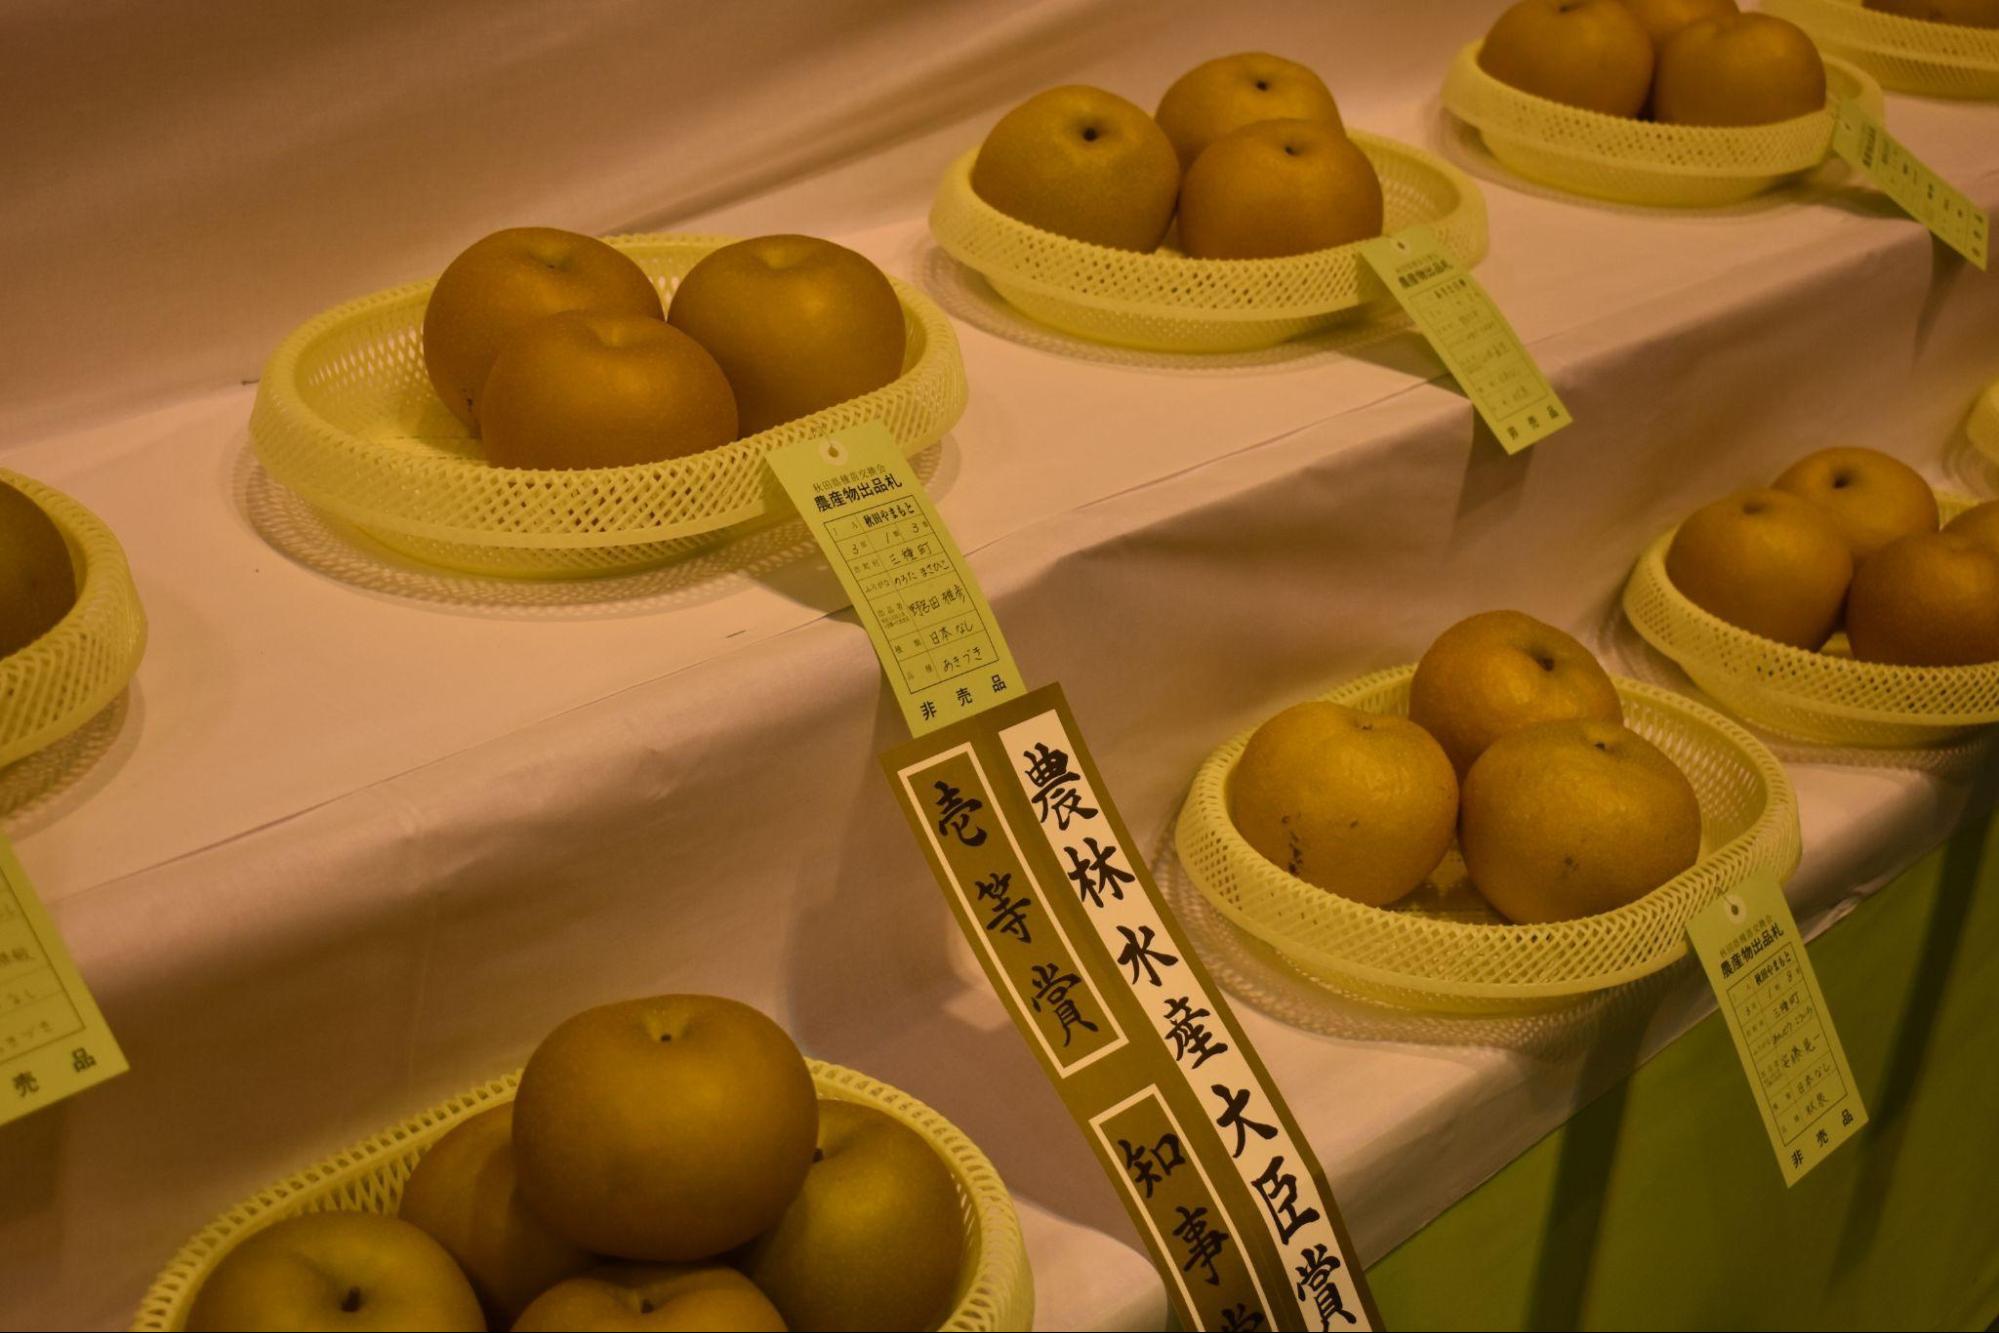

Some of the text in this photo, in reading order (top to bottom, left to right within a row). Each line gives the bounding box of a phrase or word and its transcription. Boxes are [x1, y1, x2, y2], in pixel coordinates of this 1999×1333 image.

[814, 473, 903, 513] 農産物出品札
[863, 501, 915, 528] 秋田やまもと
[920, 674, 1007, 721] 非売品
[934, 780, 1098, 1048] 壱等賞
[1720, 922, 1785, 979] 農産物出品札
[1021, 741, 1357, 1332] 農林水産大臣賞
